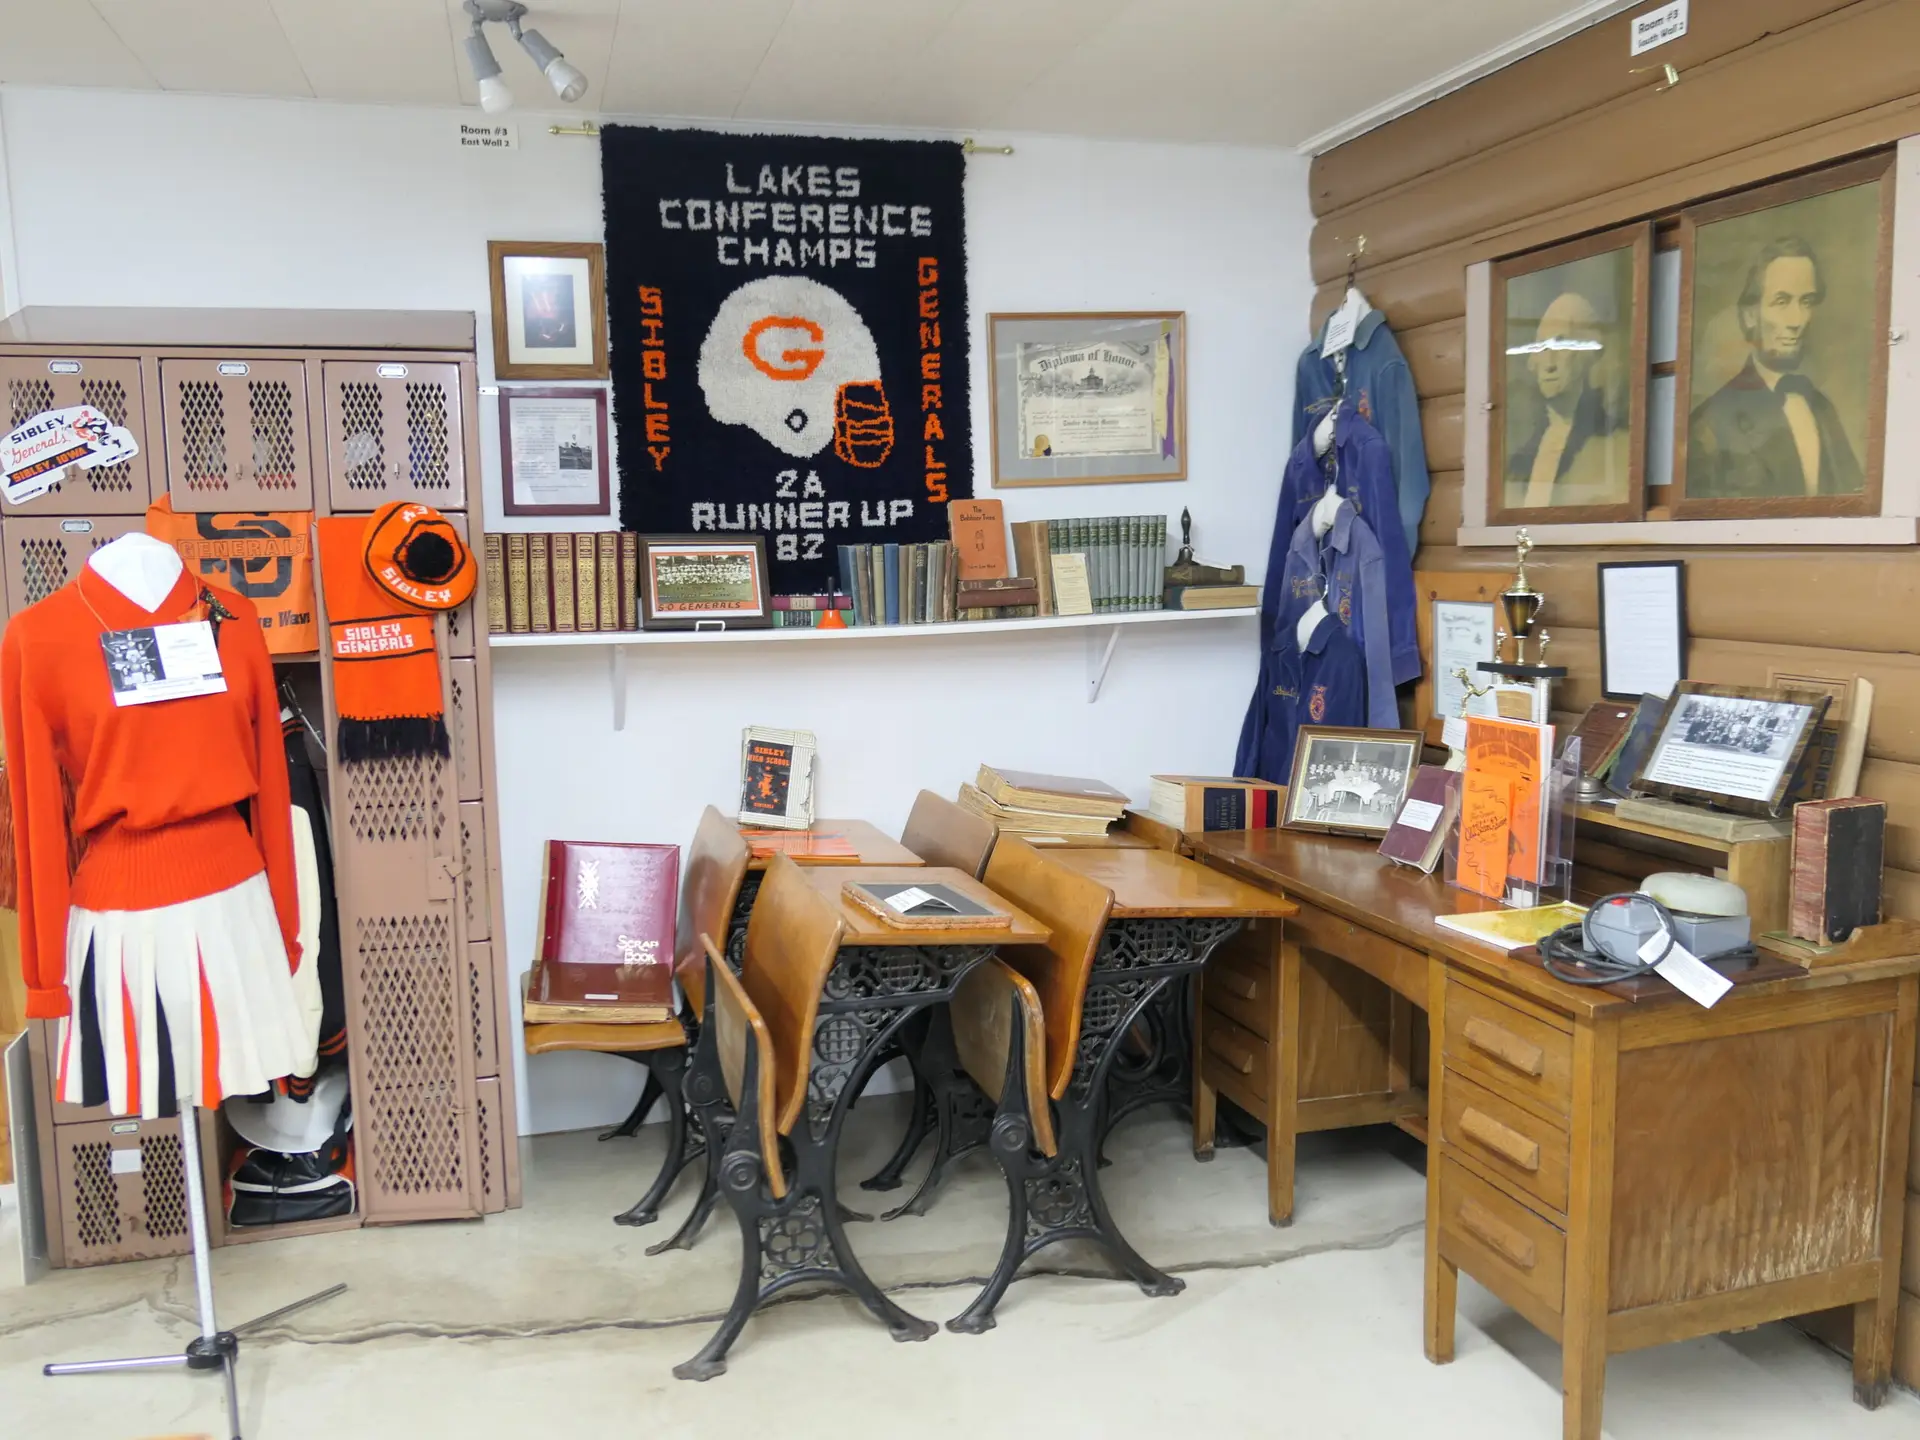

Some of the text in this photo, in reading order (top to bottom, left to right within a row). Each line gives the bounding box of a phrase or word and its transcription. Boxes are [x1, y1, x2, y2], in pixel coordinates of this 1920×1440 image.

[1638, 9, 1679, 34] Room #3
[1661, 24, 1678, 37] Wall
[460, 125, 508, 136] Room #3
[461, 138, 480, 146] East
[482, 138, 502, 147] Wall
[725, 162, 861, 199] LAKES
[658, 198, 933, 238] CONFERENCE
[717, 238, 877, 269] CHAMPS
[742, 314, 826, 382] G
[1038, 349, 1137, 371] Diploma of Honor
[638, 284, 671, 472] SIBLEY
[917, 256, 949, 503] GENERALS
[11, 415, 65, 444] SIBLEY
[12, 446, 89, 483] SIBLEY, IOWA
[775, 470, 826, 499] 2A
[691, 499, 915, 532] RUNNER UP
[179, 535, 306, 558] GENERALS
[776, 534, 825, 562] 82
[381, 567, 452, 602] SIBLEY
[679, 601, 741, 610] GENERALS
[337, 634, 413, 653] GENERALS
[345, 623, 401, 641] SIBLEY
[748, 754, 790, 766] HIGH SCHOOL
[754, 747, 785, 757] SIBLEY
[616, 935, 659, 951] SCRAP
[624, 950, 657, 965] BOOK
